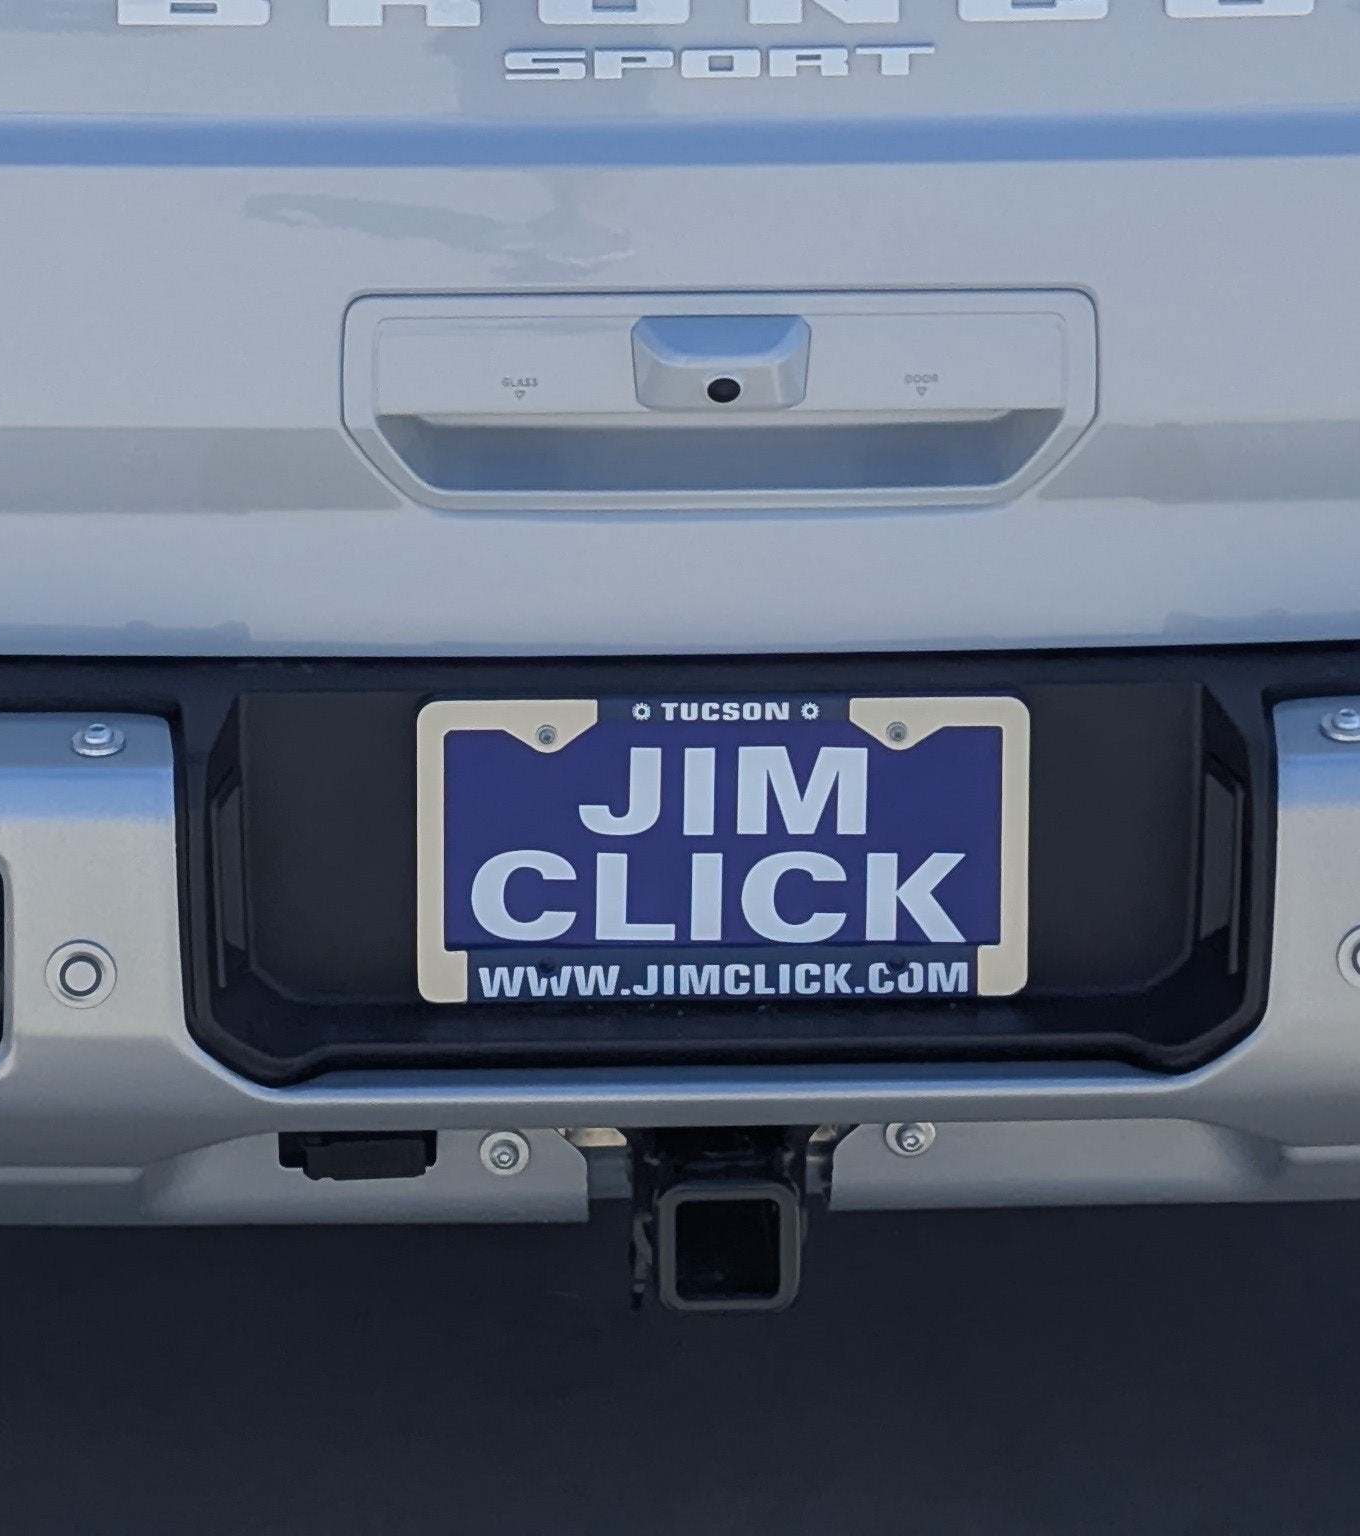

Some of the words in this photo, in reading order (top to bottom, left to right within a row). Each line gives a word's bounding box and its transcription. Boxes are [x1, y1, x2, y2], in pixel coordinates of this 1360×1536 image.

[503, 43, 936, 81] SPORT
[904, 373, 939, 384] DOOR
[660, 701, 791, 722] TUCSON
[578, 745, 869, 836] JIM
[470, 849, 967, 943] CLICK
[478, 961, 969, 998] WWW.JIMCLICK.COM
